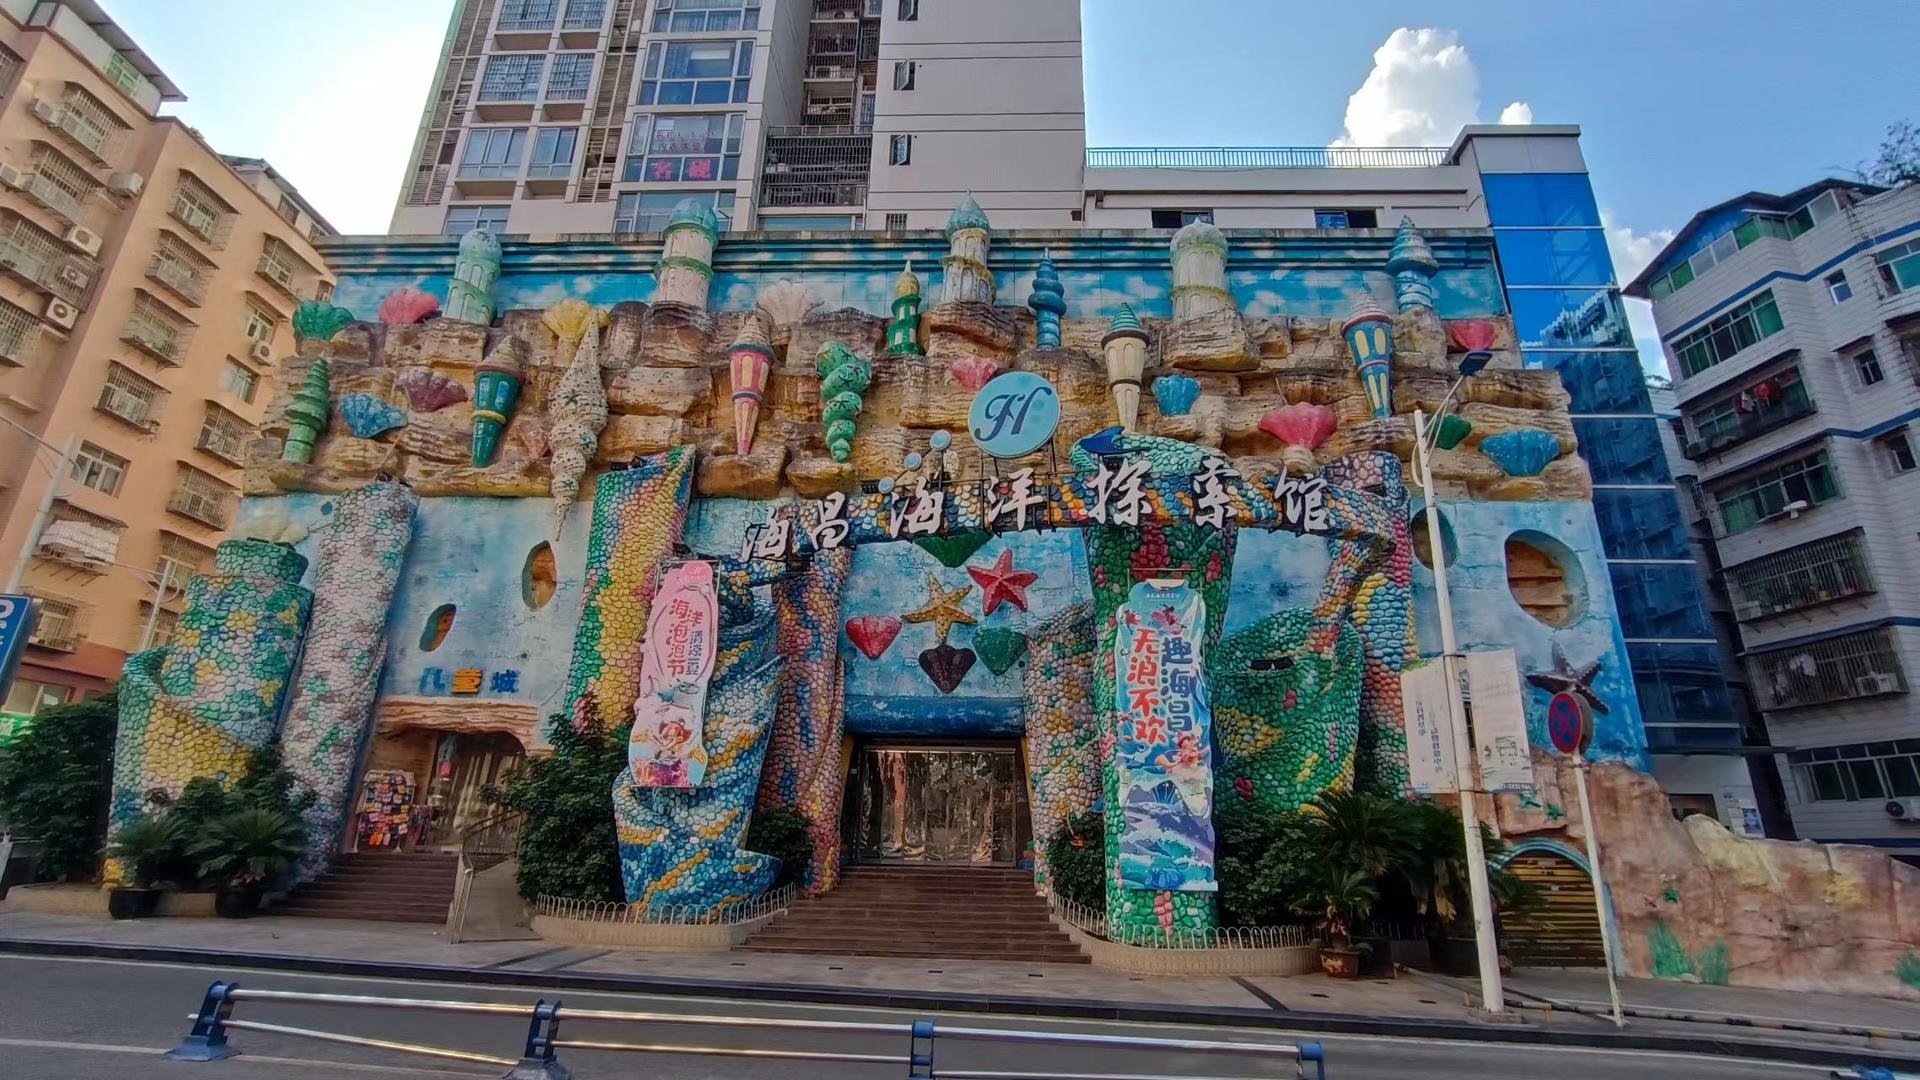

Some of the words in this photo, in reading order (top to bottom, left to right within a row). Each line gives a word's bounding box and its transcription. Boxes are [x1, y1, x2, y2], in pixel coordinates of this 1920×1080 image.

[740, 455, 1329, 562] 海昌海洋探索馆
[420, 667, 520, 694] 儿童城
[1126, 628, 1167, 745] 无浪不欢
[1160, 636, 1194, 733] 趣海昌
